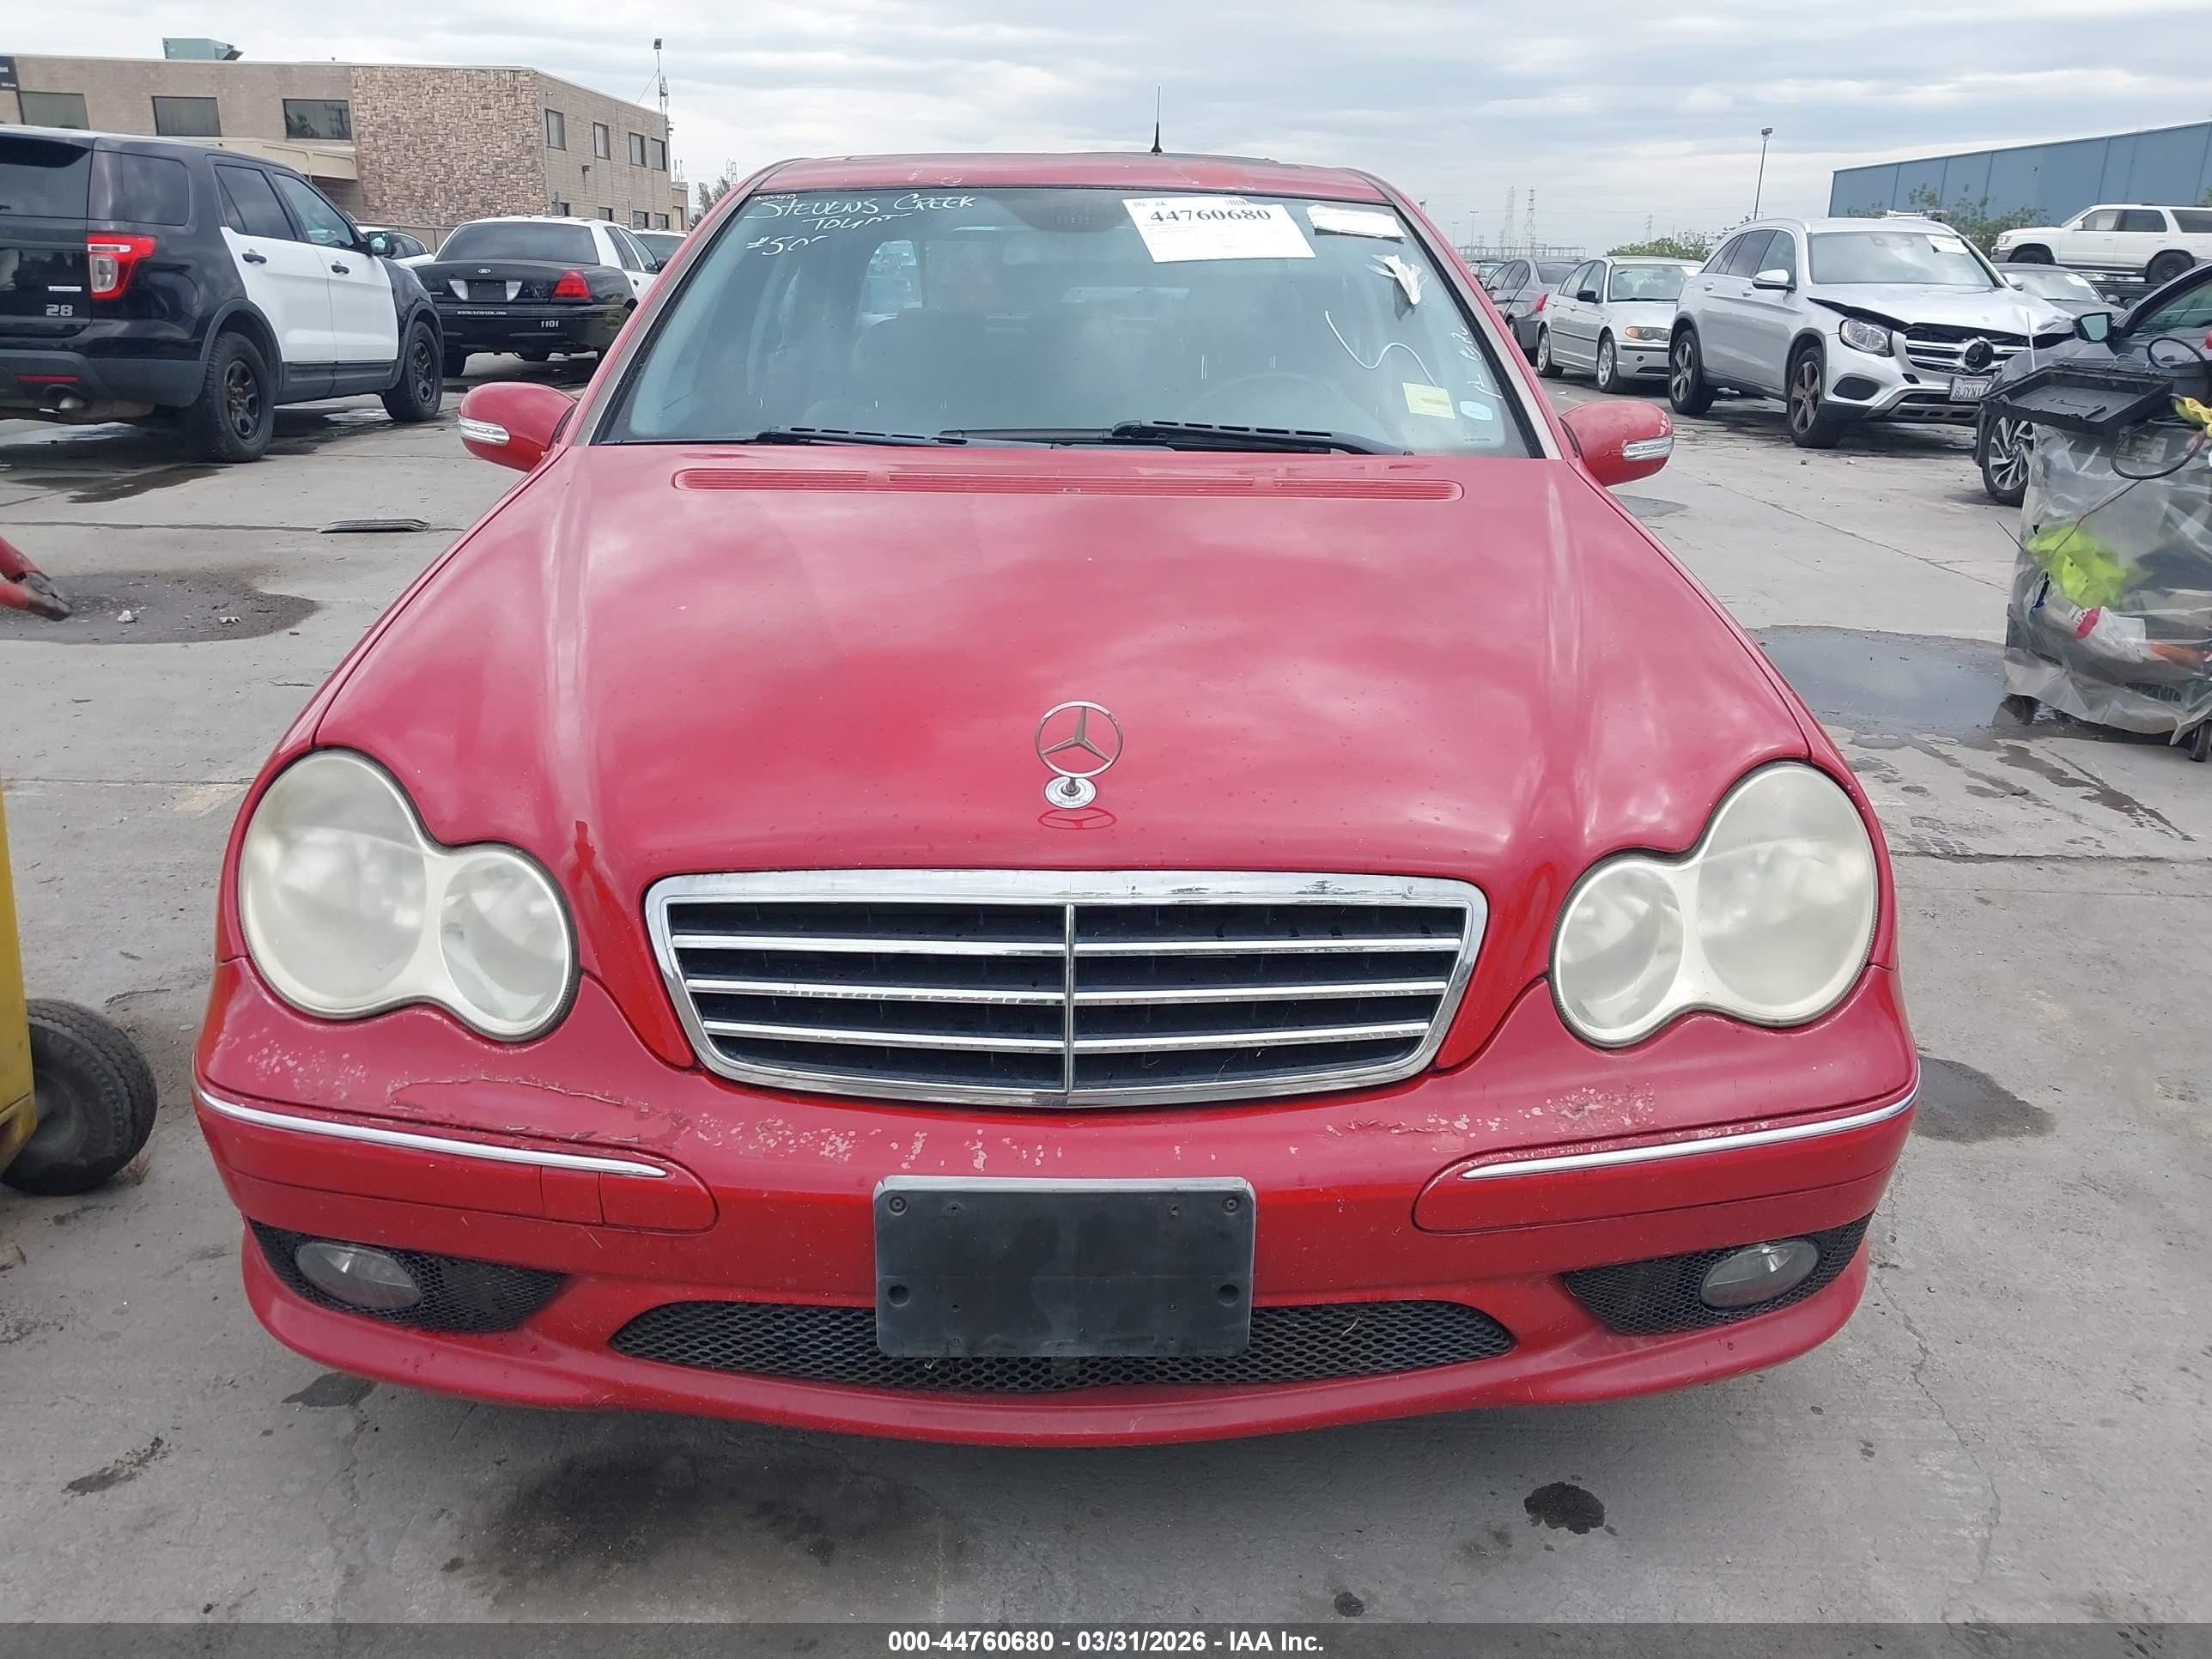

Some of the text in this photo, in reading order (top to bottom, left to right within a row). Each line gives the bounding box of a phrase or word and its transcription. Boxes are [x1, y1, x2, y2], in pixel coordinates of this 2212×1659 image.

[893, 193, 976, 213] CREEK
[1150, 209, 1272, 222] 44760680
[46, 304, 73, 317] 28
[540, 319, 559, 328] 1101
